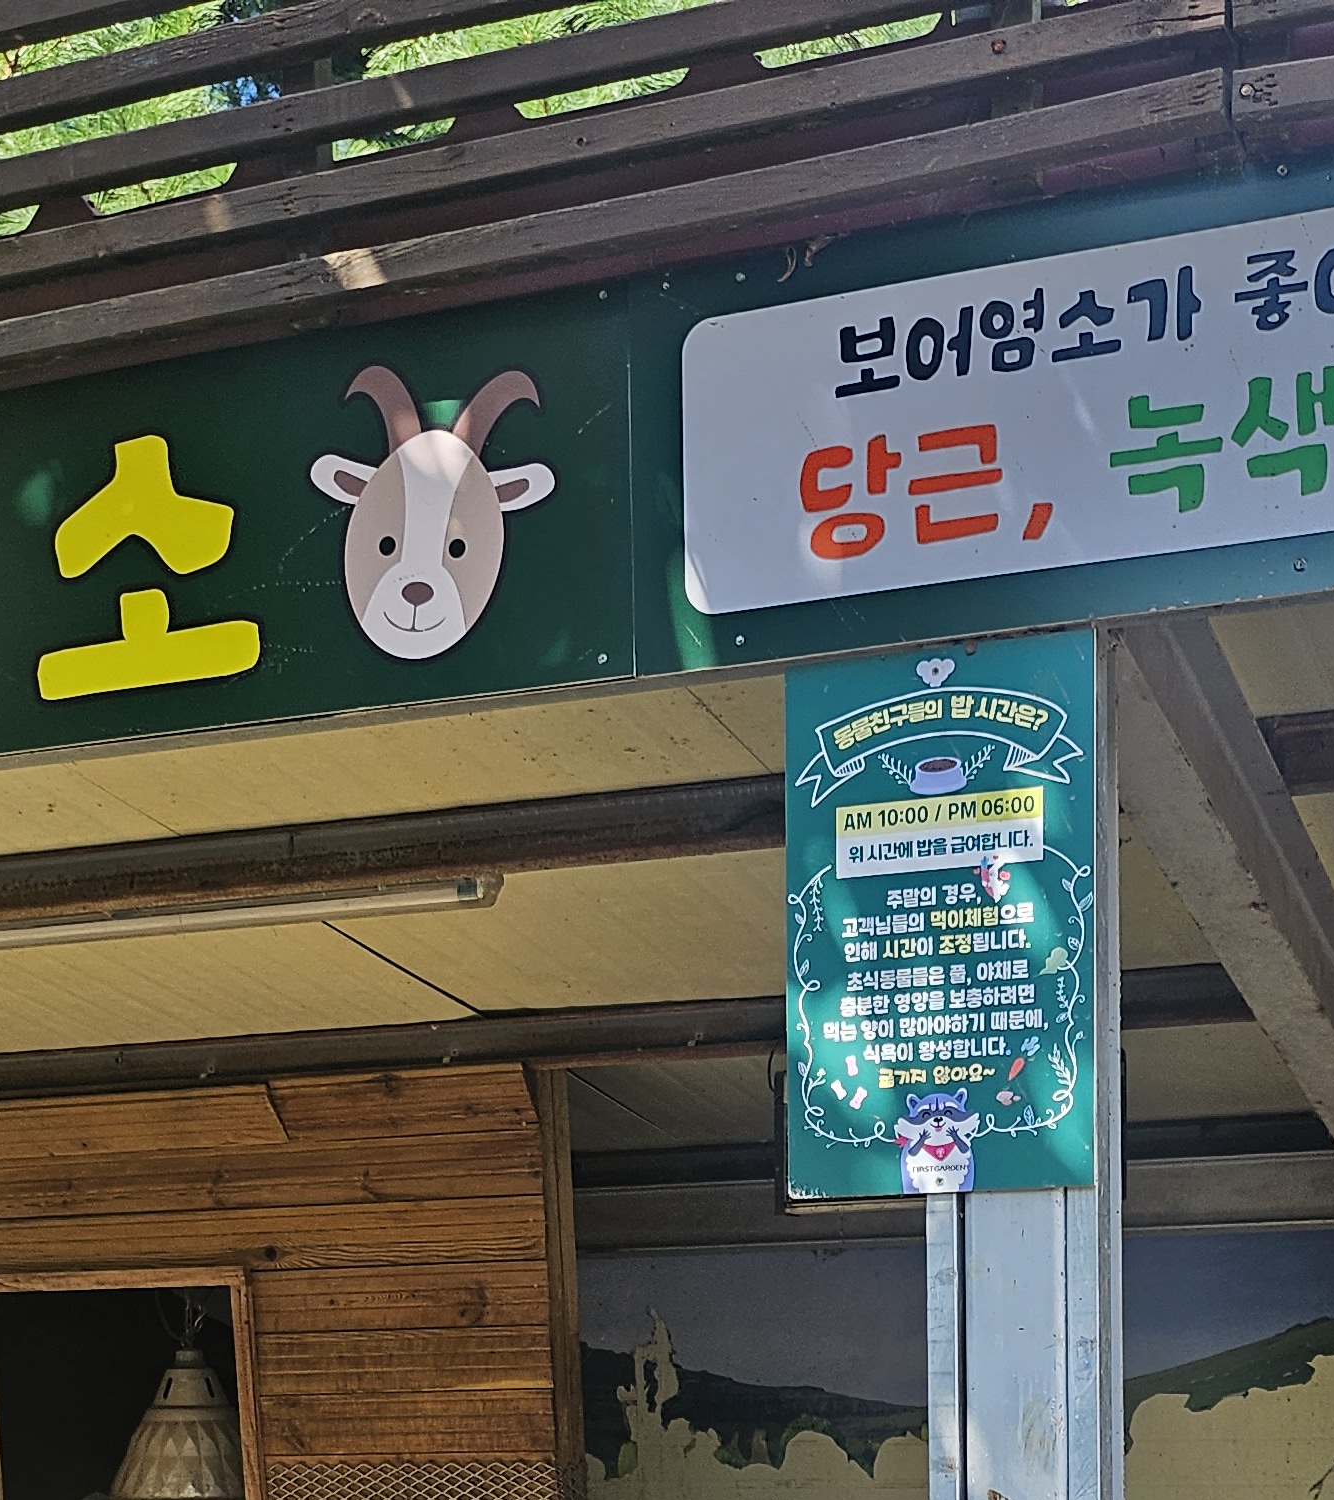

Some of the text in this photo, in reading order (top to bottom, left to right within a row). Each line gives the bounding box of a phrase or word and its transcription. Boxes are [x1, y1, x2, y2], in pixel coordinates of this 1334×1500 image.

[835, 265, 1201, 399] 보어염소가
[799, 423, 1054, 561] 당근,
[833, 694, 1049, 750] 동물친구들의 밥 시간은?
[844, 811, 872, 832] AM
[877, 805, 928, 828] 10:00
[948, 800, 977, 821] PM
[981, 795, 1035, 816] 06:00
[849, 830, 1034, 864] 위 시간에 밥을 급여합니다.
[886, 883, 982, 909] 주말의 경우,
[841, 902, 1035, 938] 고객님들의 먹이체험으로
[844, 928, 1031, 963] 인해 시간이 조정됩니다.
[846, 959, 1030, 992] 초식동물들은 풀, 야채로
[840, 983, 1035, 1017] 충분한 영양을 보충하려면
[823, 1008, 1049, 1043] 먹는 양이 많아야하기 때문에,
[863, 1036, 1012, 1065] 식욕이 왕성합니다.
[878, 1063, 995, 1089] 굶기지 않아요~
